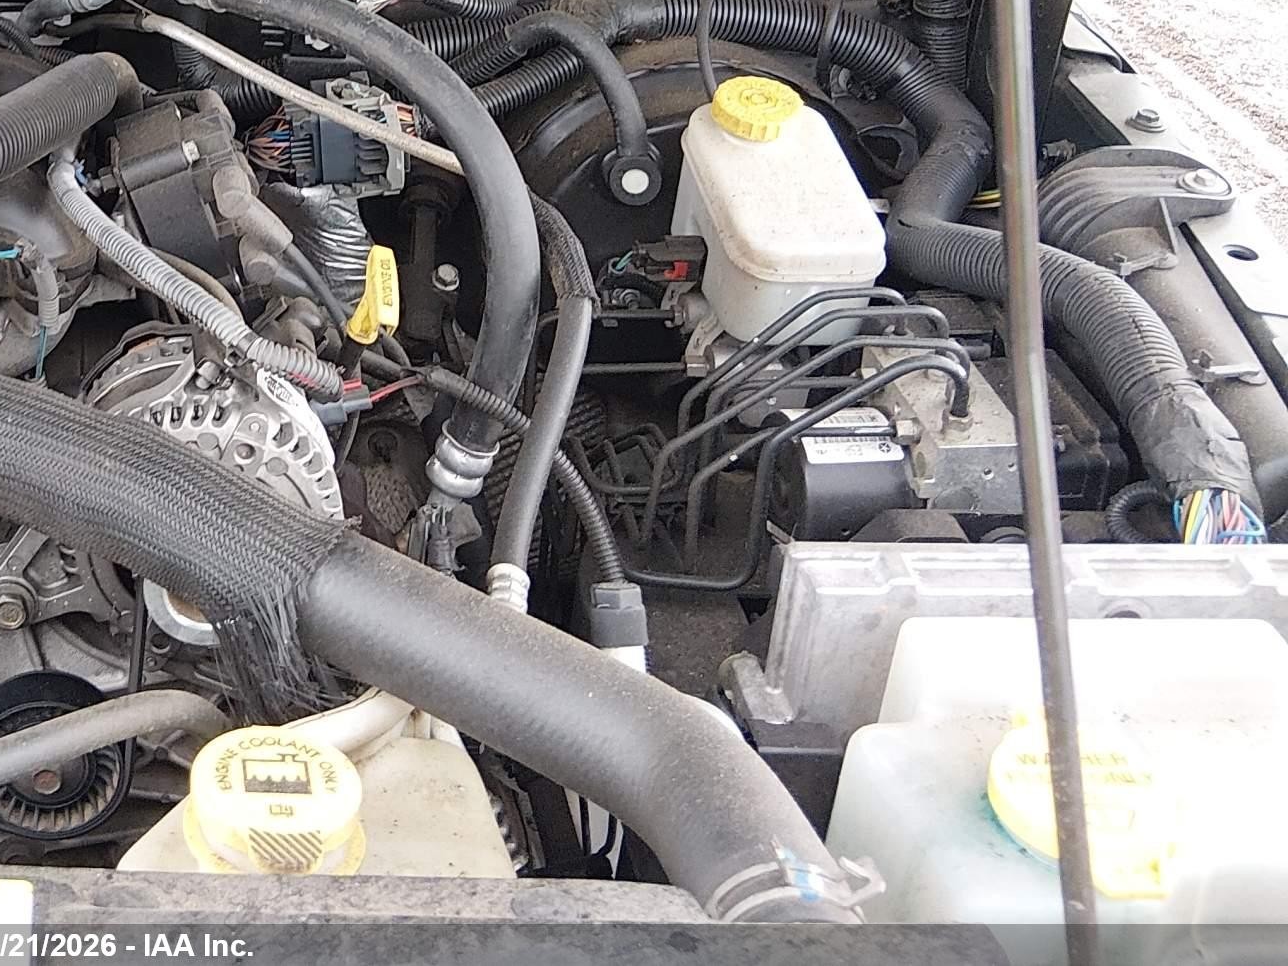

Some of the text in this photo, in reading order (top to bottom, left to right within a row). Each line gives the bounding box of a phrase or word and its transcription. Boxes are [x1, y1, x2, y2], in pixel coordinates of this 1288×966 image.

[215, 736, 338, 794] ENGINE COOLANT ONLY
